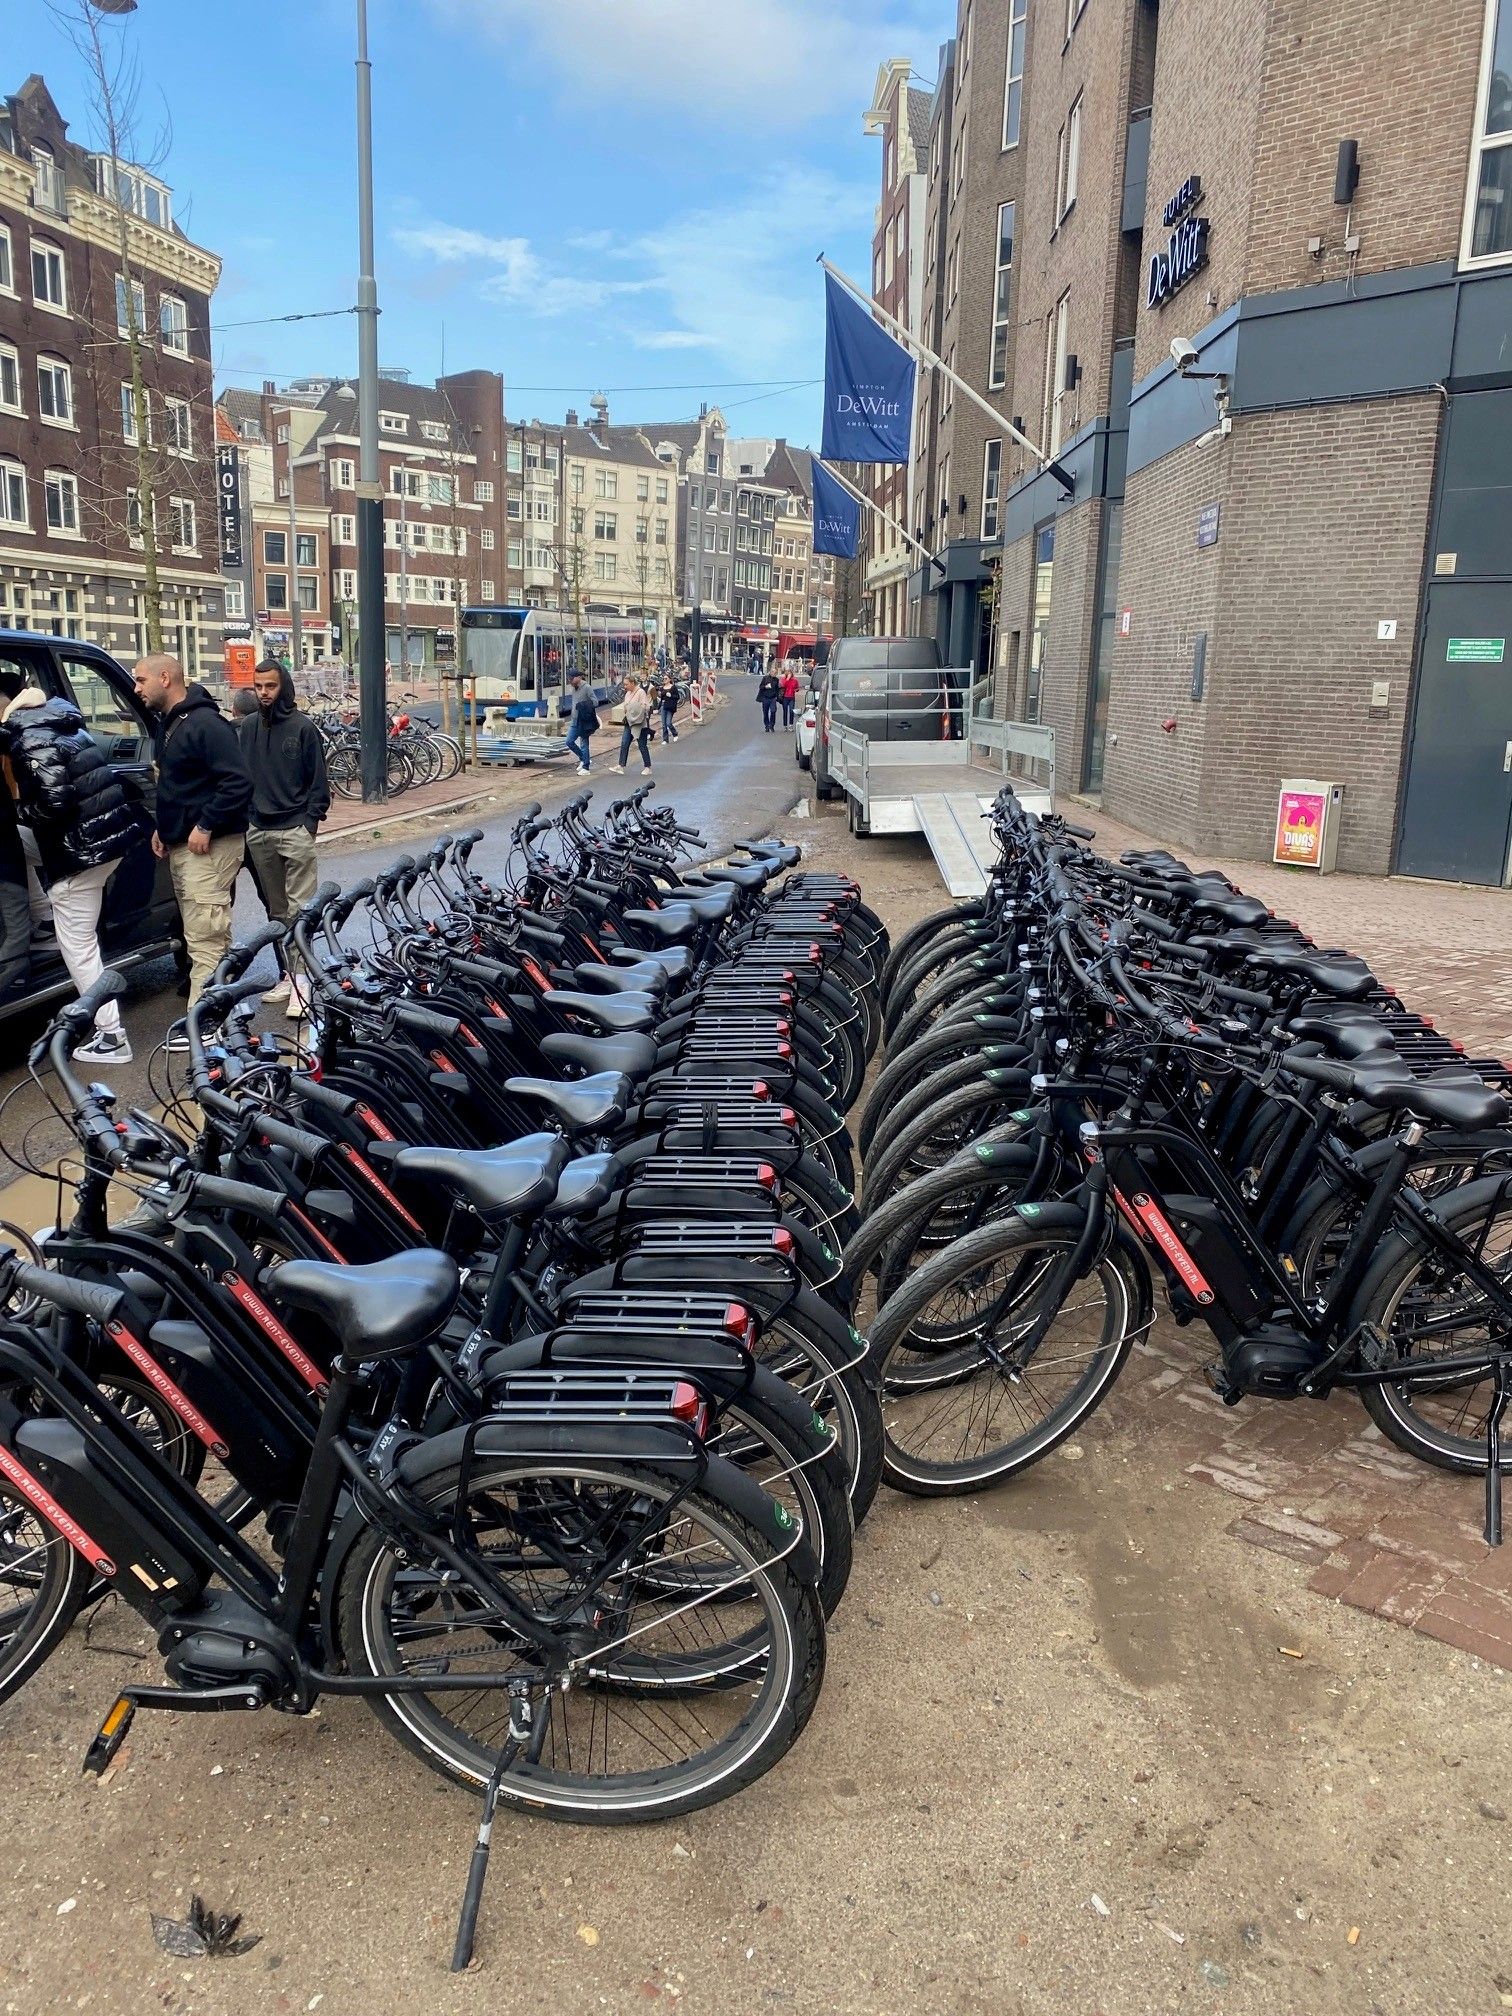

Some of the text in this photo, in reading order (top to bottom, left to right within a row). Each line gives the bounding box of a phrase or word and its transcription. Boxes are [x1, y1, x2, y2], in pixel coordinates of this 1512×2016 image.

[1163, 177, 1199, 225] HOTEL
[1147, 218, 1204, 310] DeWitt
[837, 394, 900, 416] DeWitt
[221, 449, 236, 554] HOTEL
[819, 519, 851, 534] DeWitt
[1384, 624, 1391, 636] 7
